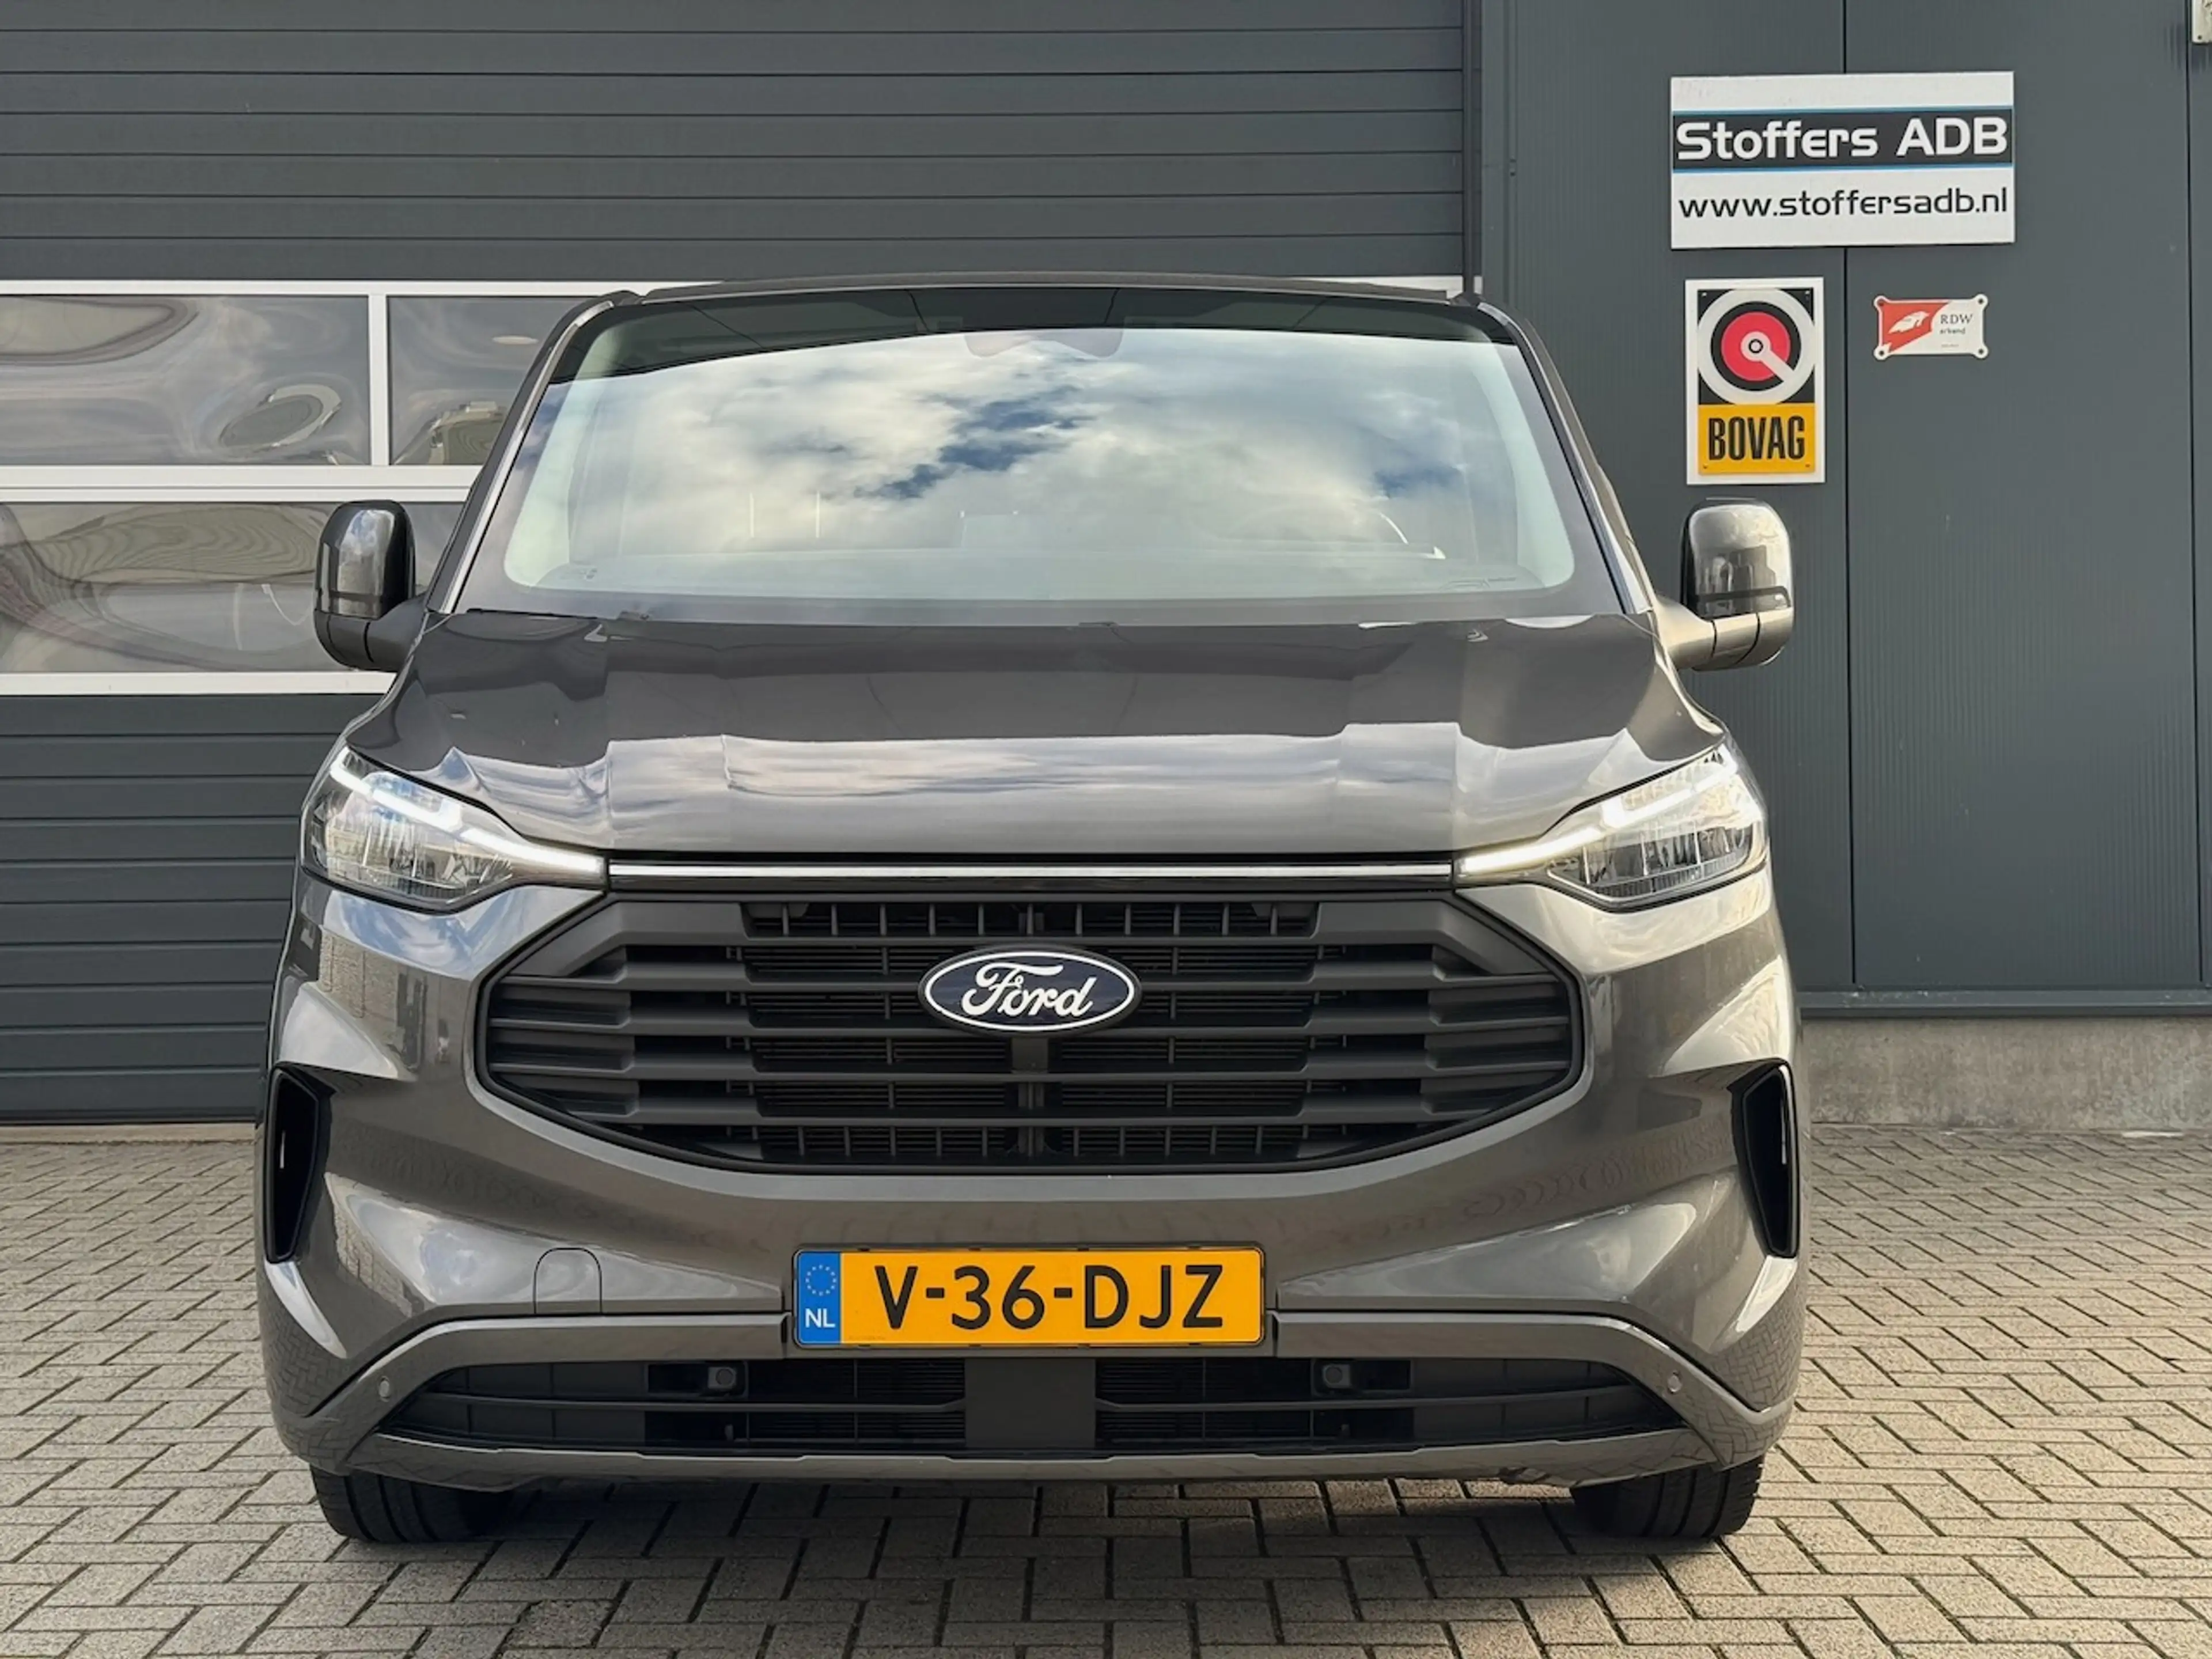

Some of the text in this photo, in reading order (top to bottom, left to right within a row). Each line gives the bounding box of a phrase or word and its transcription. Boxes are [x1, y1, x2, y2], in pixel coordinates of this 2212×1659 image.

[1676, 117, 2007, 160] Stoffers ADB
[1678, 187, 2007, 218] www.stoffersadb.nl
[1940, 314, 1973, 324] RDW
[1709, 416, 1805, 460] BOVAG
[961, 962, 1097, 1017] Ford
[805, 1308, 835, 1328] NL
[874, 1264, 1223, 1330] V-36-DJZ
